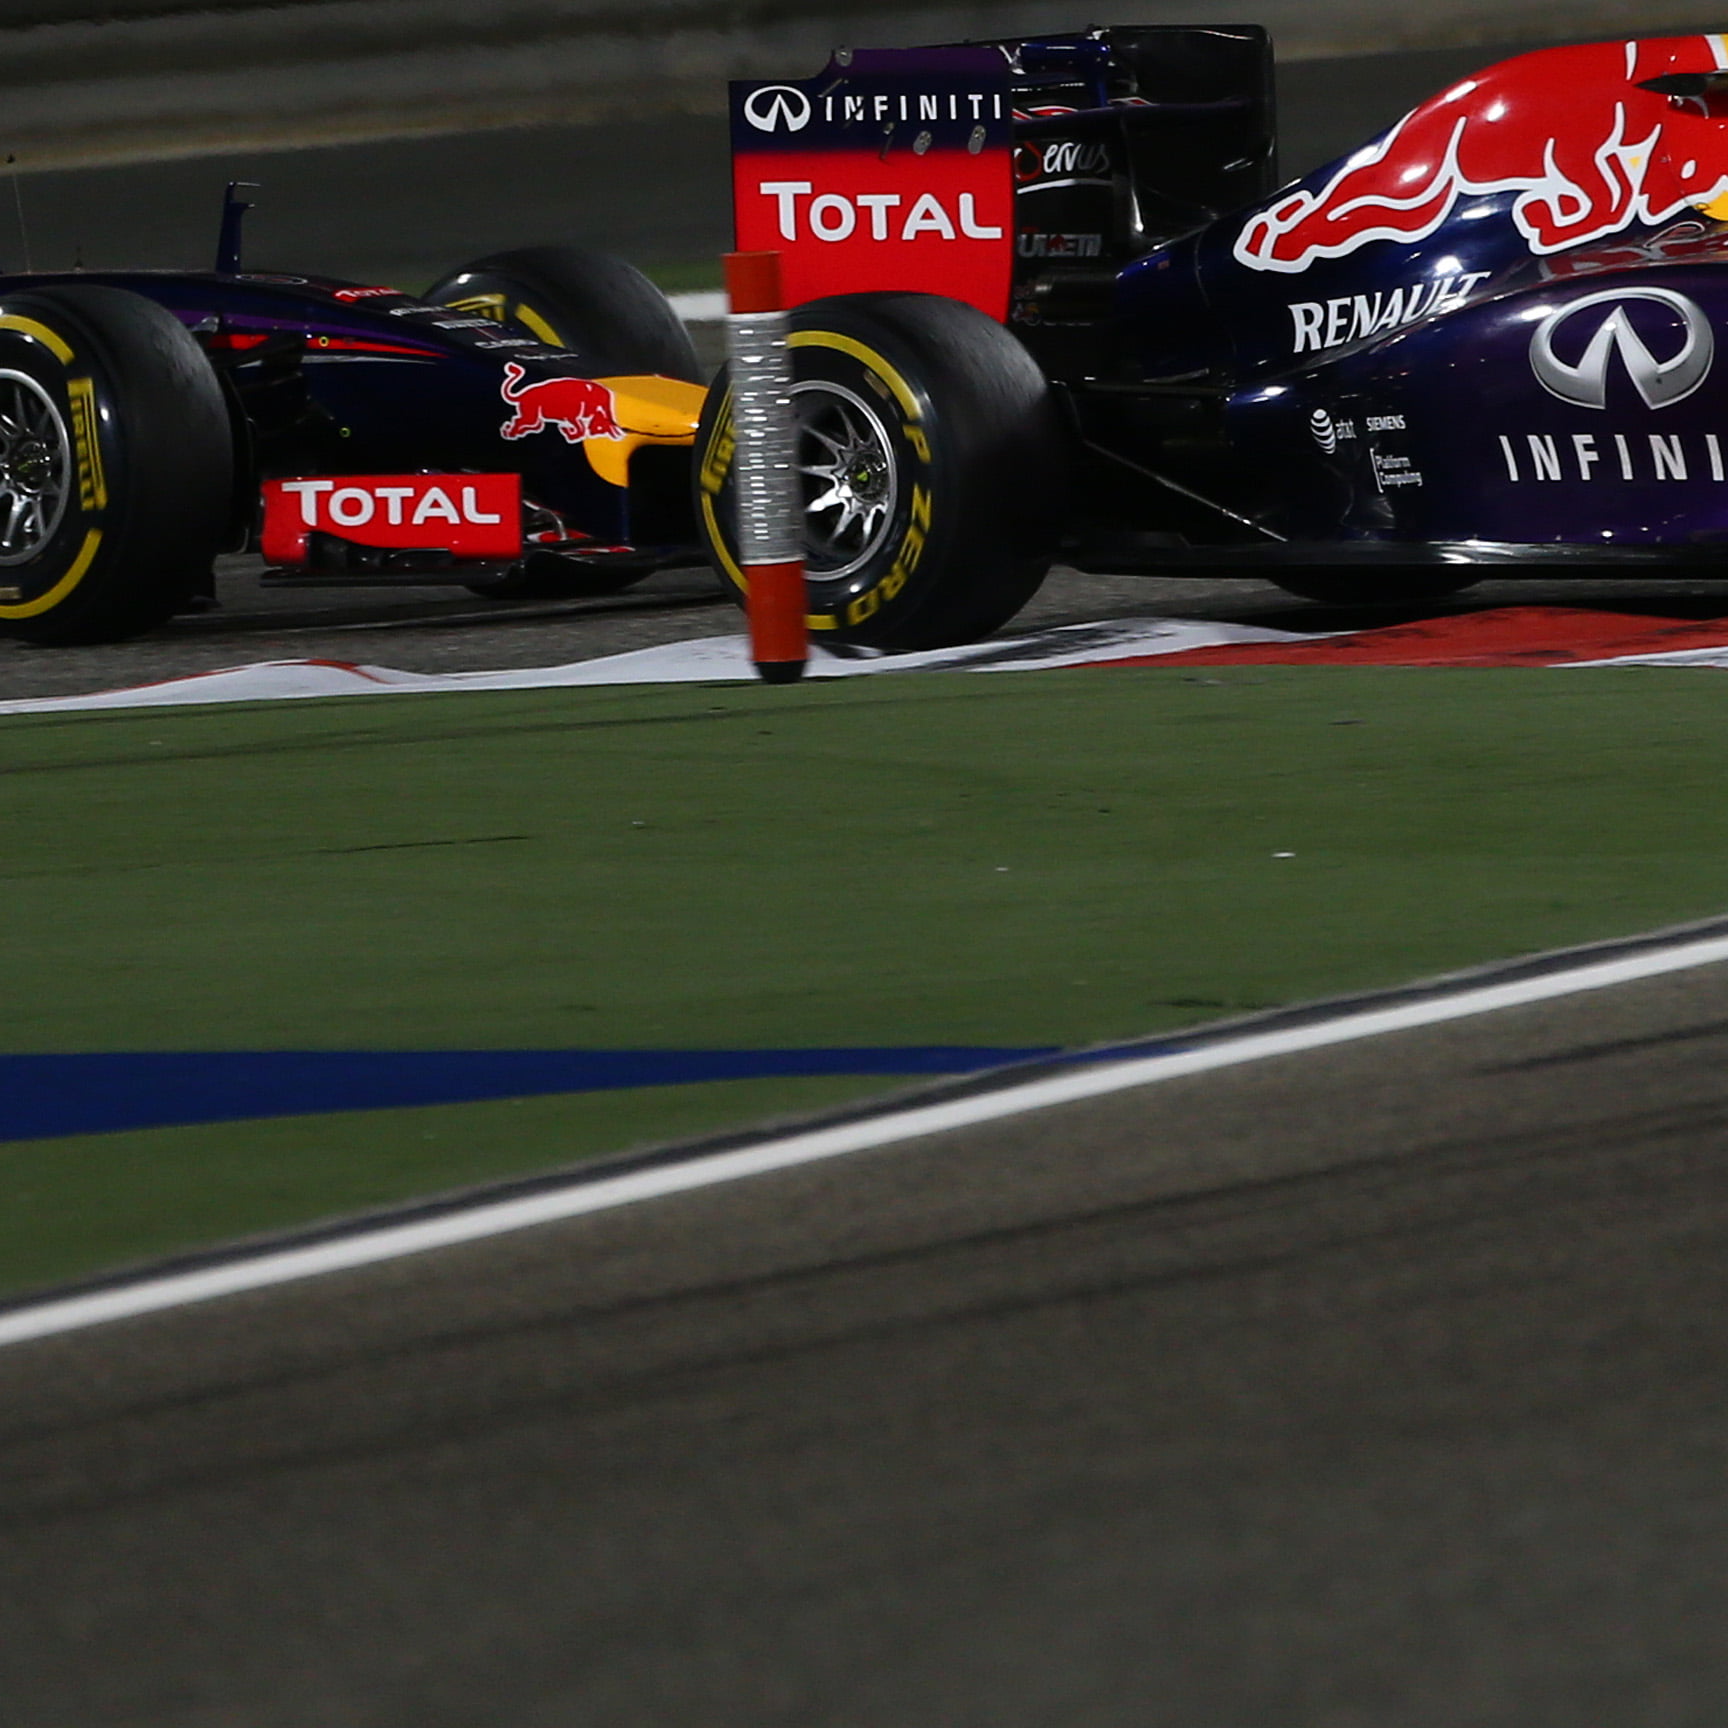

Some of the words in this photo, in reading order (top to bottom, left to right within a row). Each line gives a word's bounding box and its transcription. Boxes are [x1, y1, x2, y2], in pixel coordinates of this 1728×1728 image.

[824, 93, 1003, 122] INFINITI
[759, 180, 1004, 242] TOTAL
[1287, 271, 1493, 354] RENAULT
[66, 375, 109, 511] PIRELLI
[903, 424, 932, 464] P
[1366, 415, 1407, 432] SIEMENS
[280, 479, 503, 527] TOTAL
[846, 483, 932, 627] ZERO
